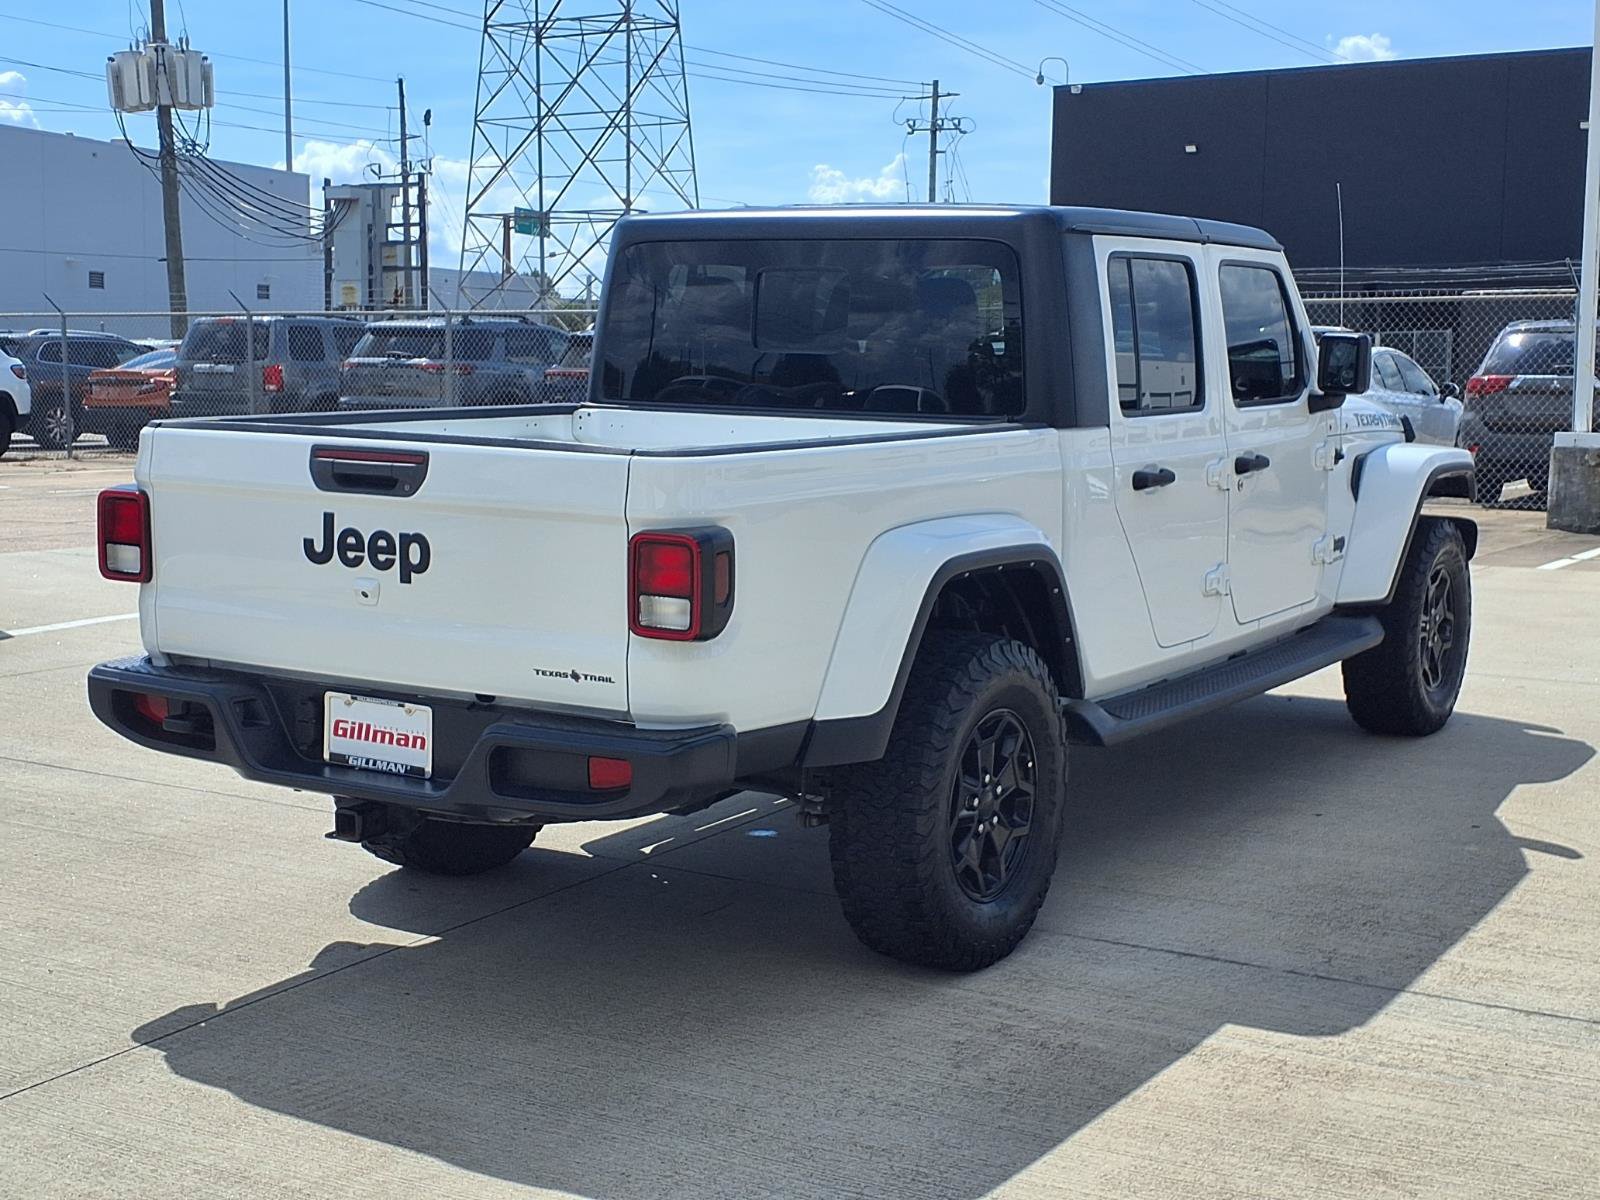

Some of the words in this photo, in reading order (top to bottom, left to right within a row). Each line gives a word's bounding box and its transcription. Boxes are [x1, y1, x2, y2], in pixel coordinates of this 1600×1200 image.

[303, 511, 431, 584] Jeep
[533, 669, 569, 679] TEXAS
[581, 674, 616, 684] TRAIL
[333, 719, 427, 751] Gillman
